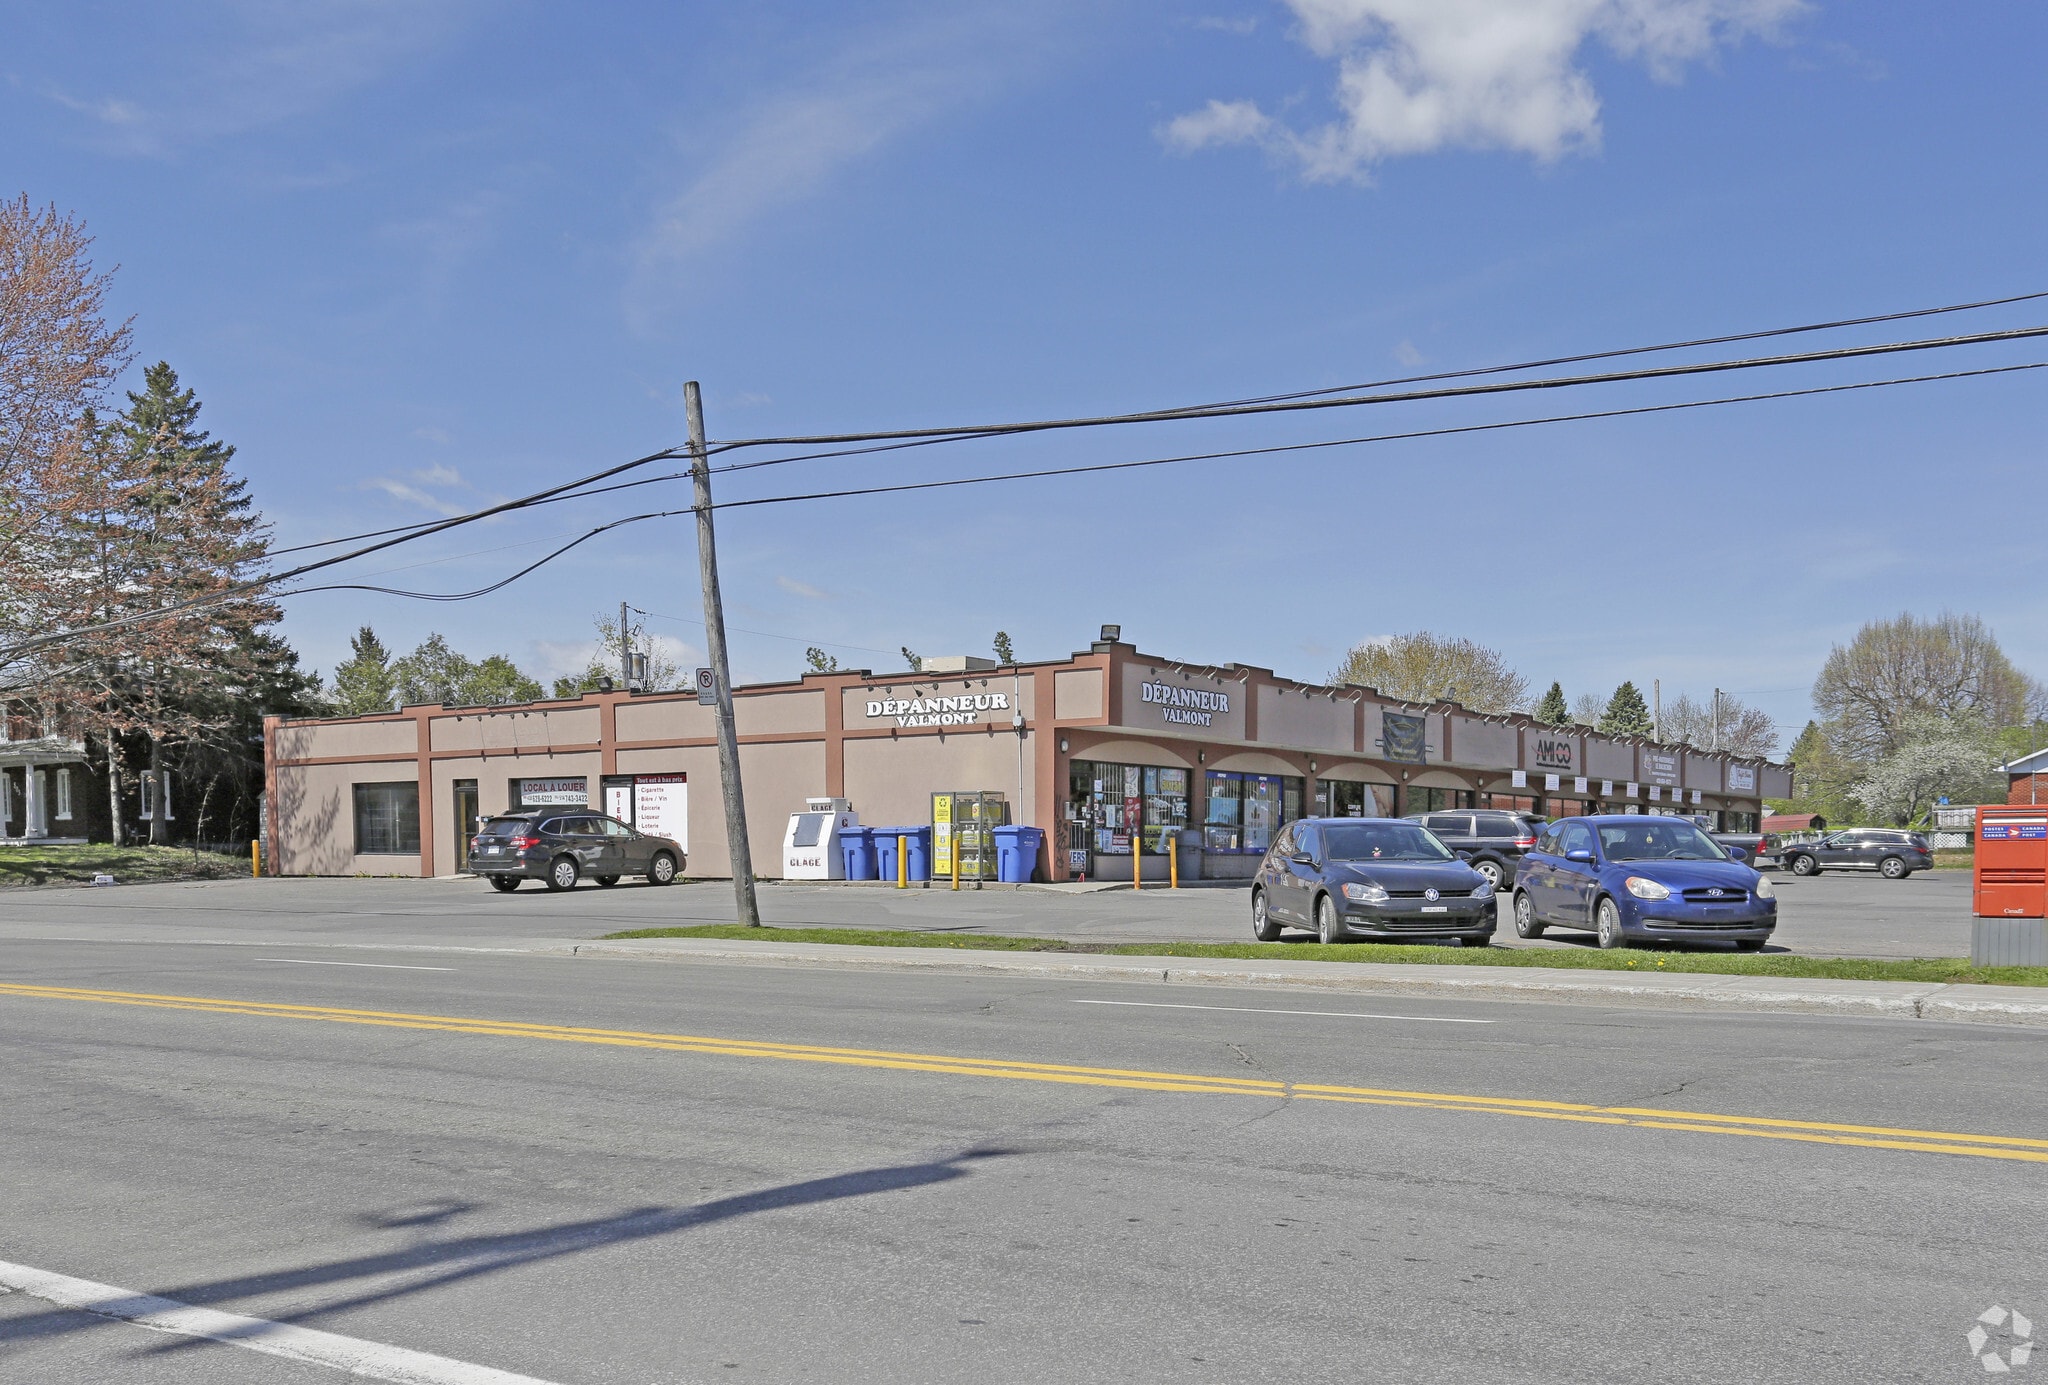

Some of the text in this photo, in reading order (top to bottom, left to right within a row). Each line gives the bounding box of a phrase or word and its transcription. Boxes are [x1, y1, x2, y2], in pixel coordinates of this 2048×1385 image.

[866, 692, 1009, 717] DÉPANNEUR
[1142, 679, 1229, 713] DÉPANNEUR
[896, 712, 977, 728] VALMONT
[1162, 707, 1212, 727] VALMONT
[523, 784, 548, 792] LOCAL
[558, 782, 586, 792] LOUER
